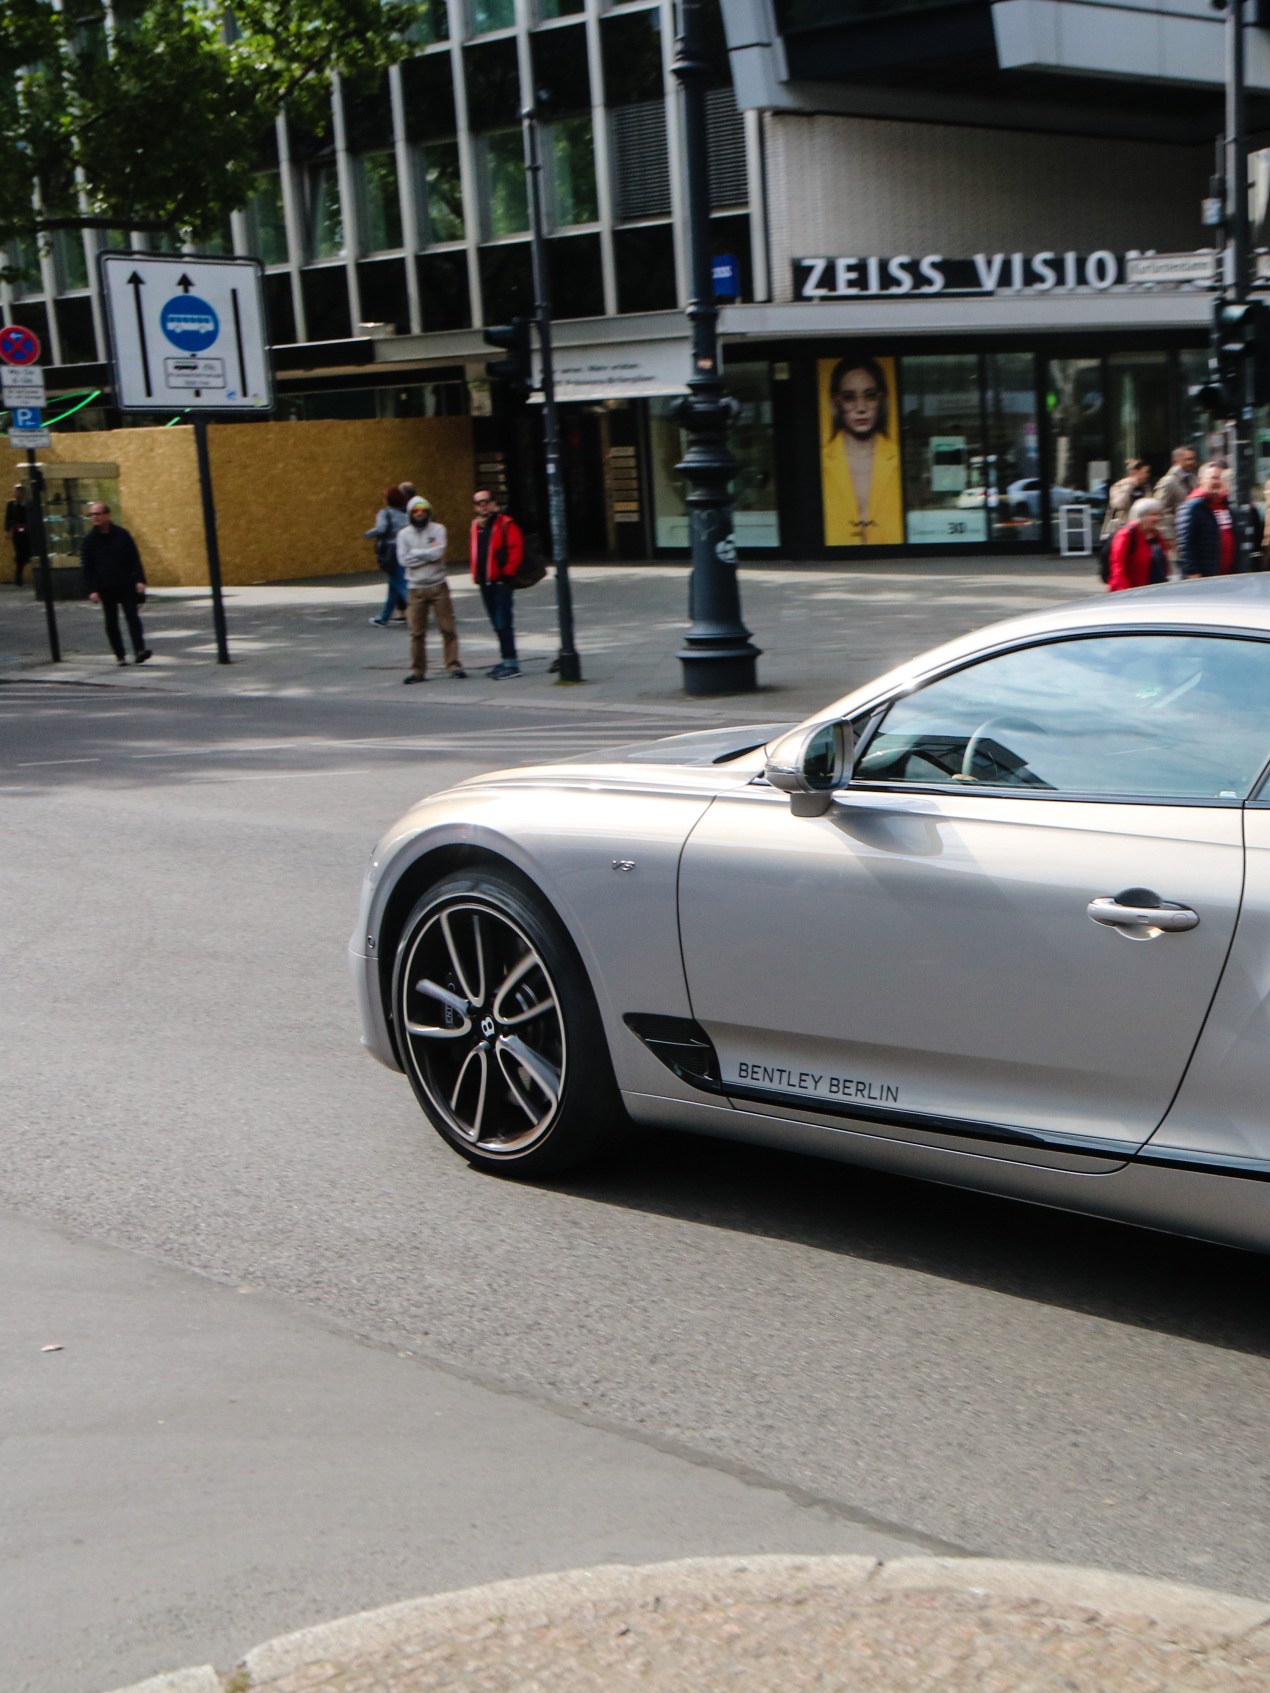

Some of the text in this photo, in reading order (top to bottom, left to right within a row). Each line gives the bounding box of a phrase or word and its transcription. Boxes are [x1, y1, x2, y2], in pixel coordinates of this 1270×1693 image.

[801, 255, 946, 296] ZEISS
[17, 409, 33, 426] P
[738, 1062, 899, 1103] BENTLEY BERLIN
